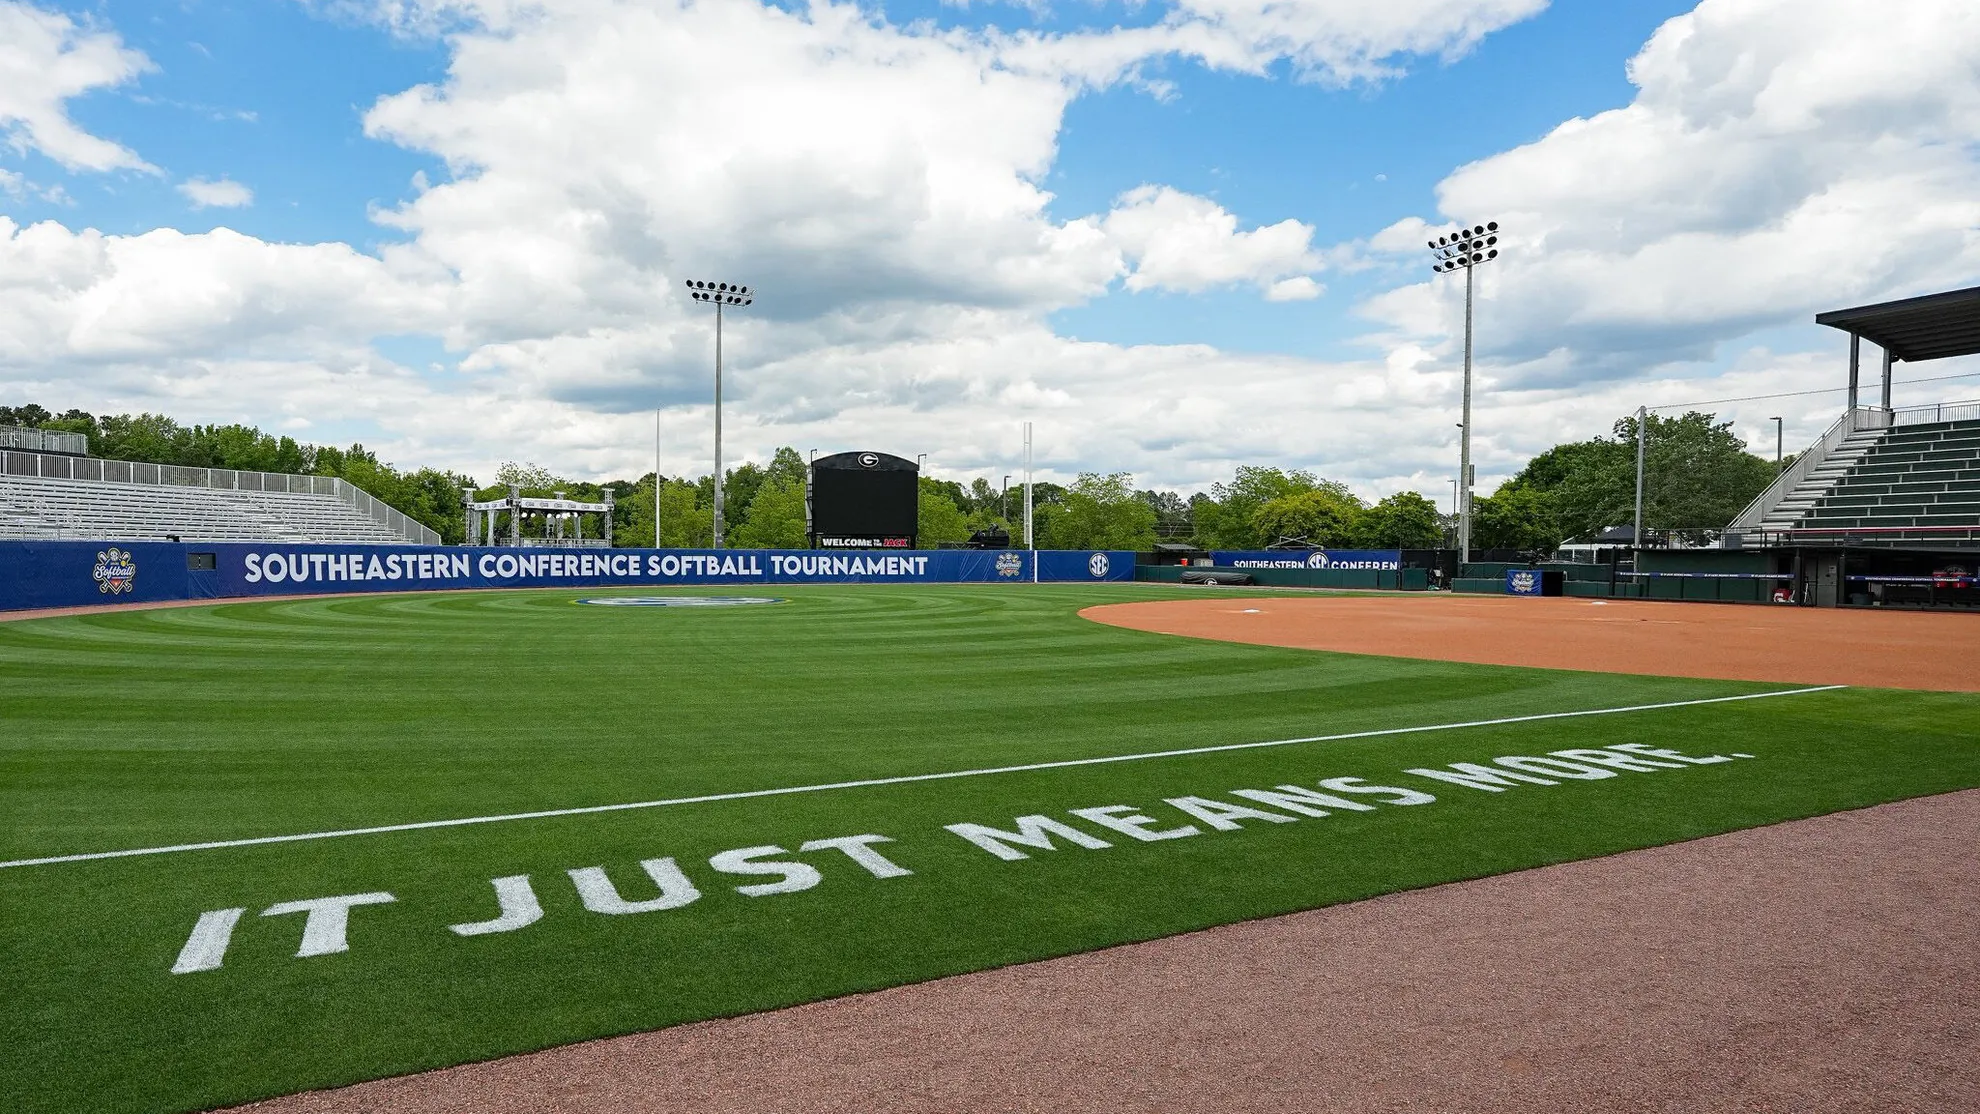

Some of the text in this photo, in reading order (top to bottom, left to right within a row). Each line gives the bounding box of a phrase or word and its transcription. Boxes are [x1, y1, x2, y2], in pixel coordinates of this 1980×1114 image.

[822, 538, 872, 547] WELCOME
[883, 538, 908, 547] JACK
[95, 565, 134, 579] Softball
[244, 553, 928, 583] SOUTHEASTERN CONFERENCE SOFTBALL TOURNAMENT
[1090, 554, 1108, 575] SEC
[1234, 561, 1305, 569] SOUTHEASTERN
[170, 743, 1756, 975] IT JUST MEANS MORE.
